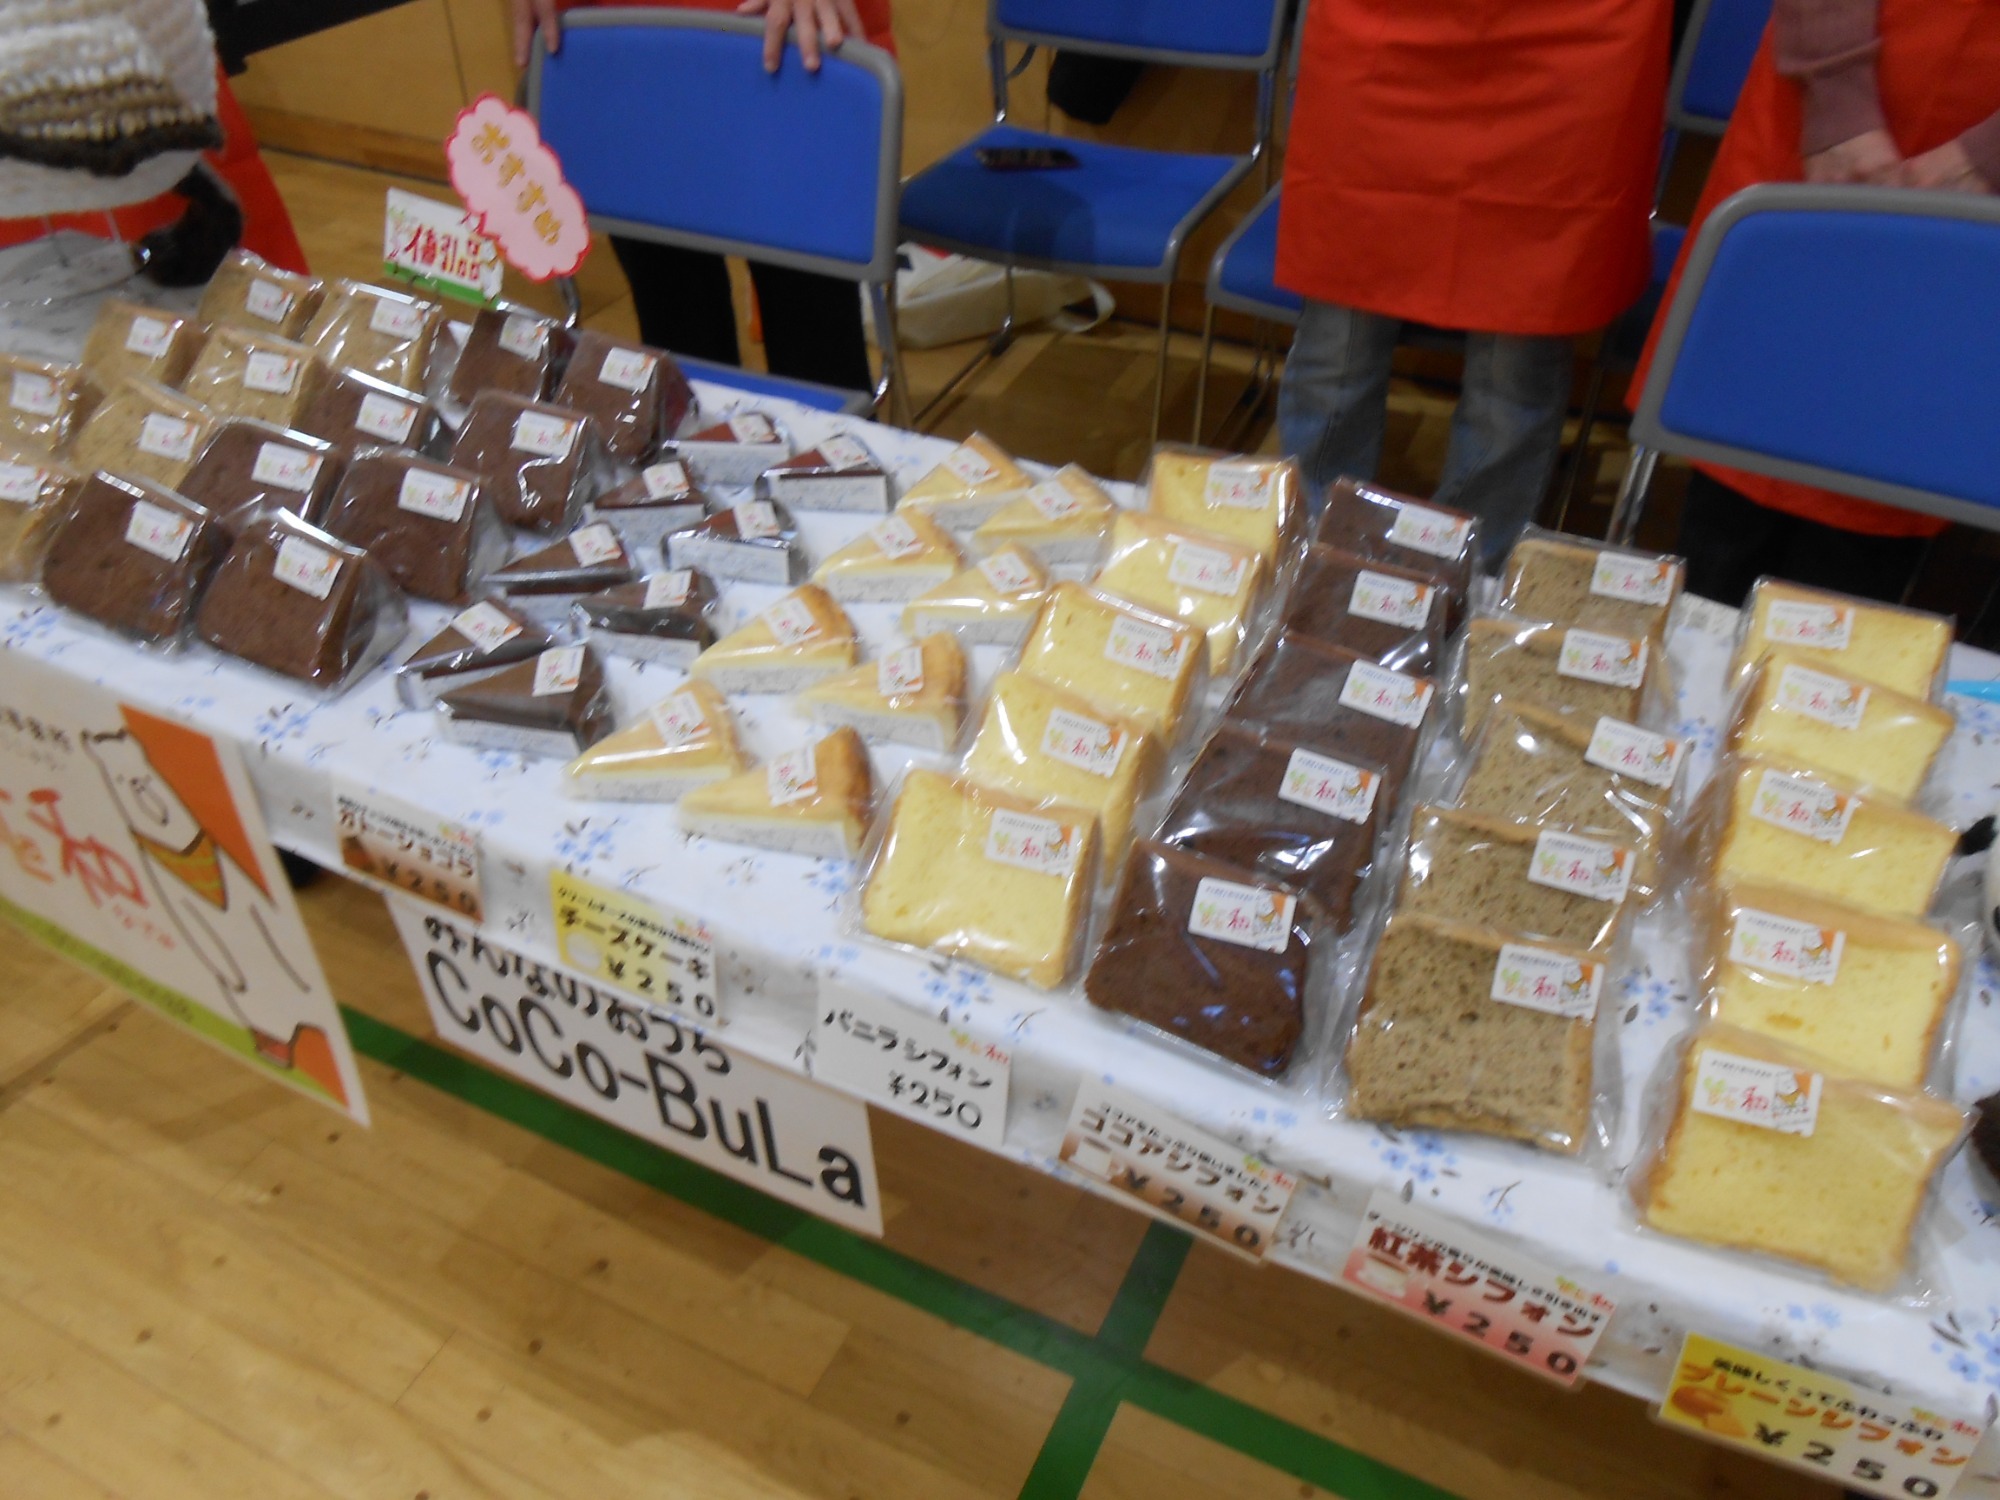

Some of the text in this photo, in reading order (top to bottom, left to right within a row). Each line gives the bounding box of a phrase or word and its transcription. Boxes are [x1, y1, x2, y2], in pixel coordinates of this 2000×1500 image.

[470, 122, 563, 245] おすすめ
[425, 950, 866, 1208] CoCo-BuLa
[823, 1009, 993, 1089] バニラシフォン
[888, 1069, 982, 1130] ¥250
[1079, 1107, 1281, 1215] ココアシフォン
[1125, 1166, 1261, 1248] ¥250
[1368, 1225, 1595, 1337] 紅茶シフォン
[1423, 1289, 1578, 1375] ¥250
[1681, 1361, 1968, 1466] プレーンシフォン
[1713, 1357, 1944, 1442] 美味しくってふわっふわ
[1753, 1422, 1939, 1499] ¥250
